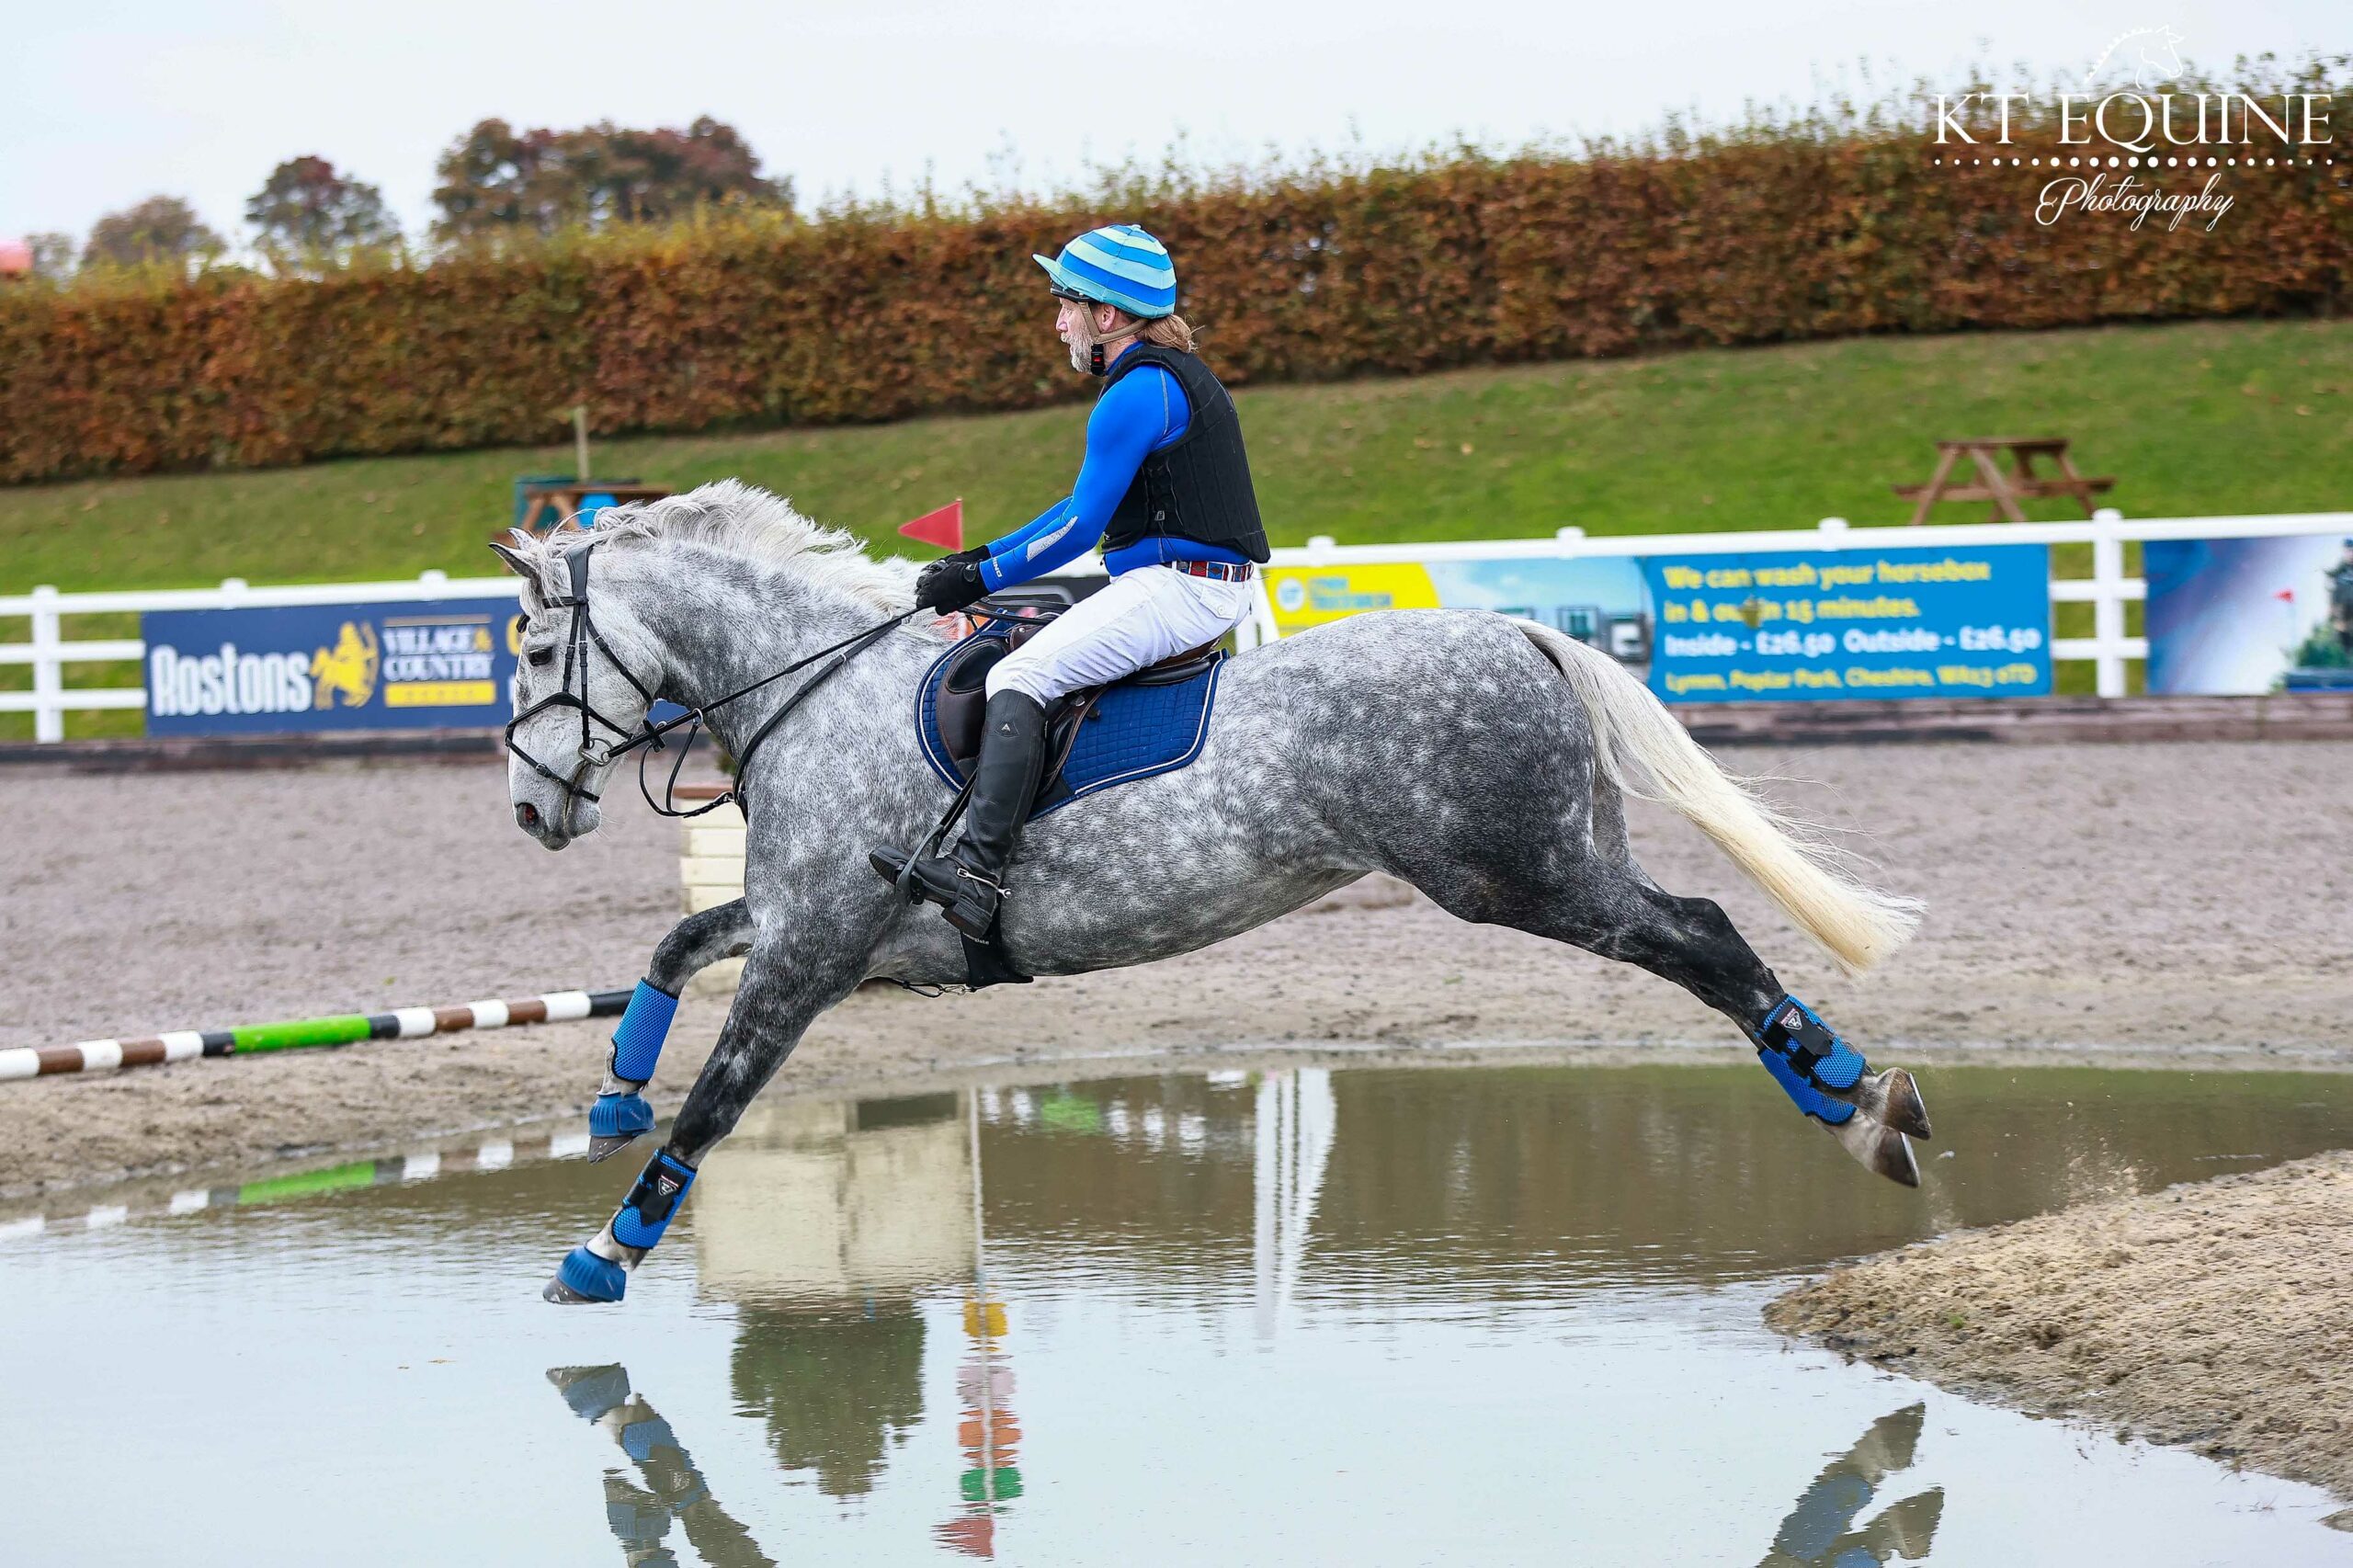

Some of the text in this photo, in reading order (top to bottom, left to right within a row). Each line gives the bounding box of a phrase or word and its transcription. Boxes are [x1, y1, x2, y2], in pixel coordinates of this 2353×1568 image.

[1663, 558, 1992, 591] We can wash your horsebox
[1664, 599, 1688, 623] in
[1712, 602, 1754, 622] ou
[1785, 599, 1814, 624] 15
[1816, 596, 1922, 619] minutes.
[383, 627, 472, 654] VILLAGE
[1665, 632, 1737, 657] Inside
[1843, 628, 1941, 653] Outside
[151, 643, 313, 716] Rostons
[383, 653, 495, 681] COUNTRY
